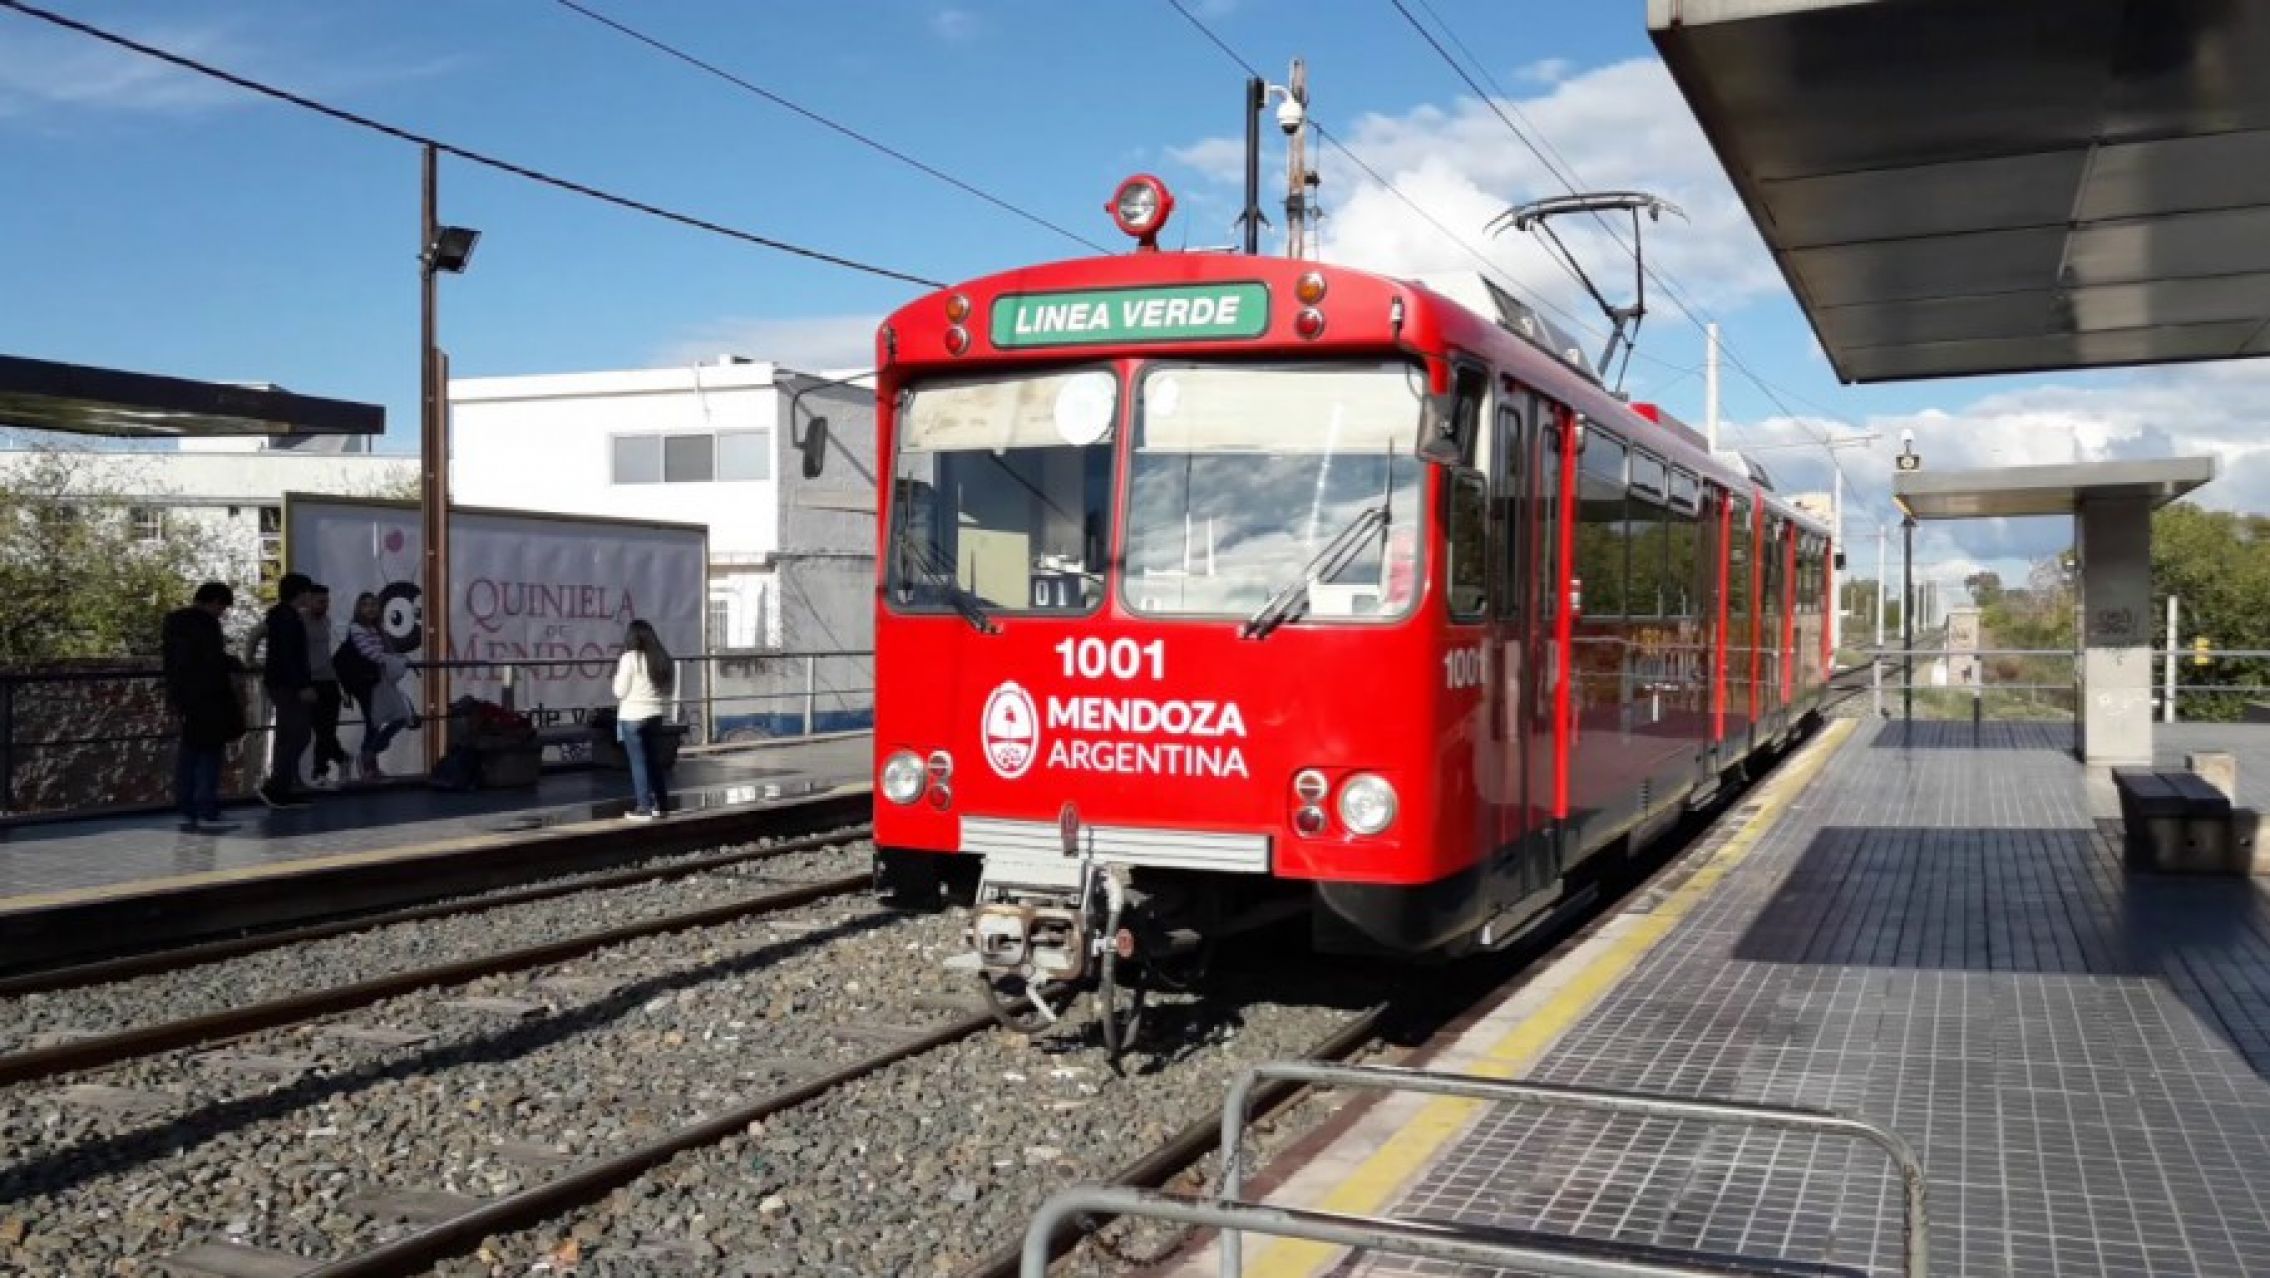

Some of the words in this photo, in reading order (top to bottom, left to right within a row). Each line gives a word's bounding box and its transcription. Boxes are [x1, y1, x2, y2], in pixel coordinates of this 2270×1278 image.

[1015, 303, 1110, 335] LINEA
[1122, 296, 1242, 328] VERDE
[466, 577, 635, 633] QUINIELA
[448, 631, 632, 681] MENDOZ
[1055, 636, 1165, 681] 1001
[1443, 647, 1488, 689] 1001
[1046, 695, 1248, 738] MENDOZA
[1046, 738, 1250, 779] ARGENTINA
